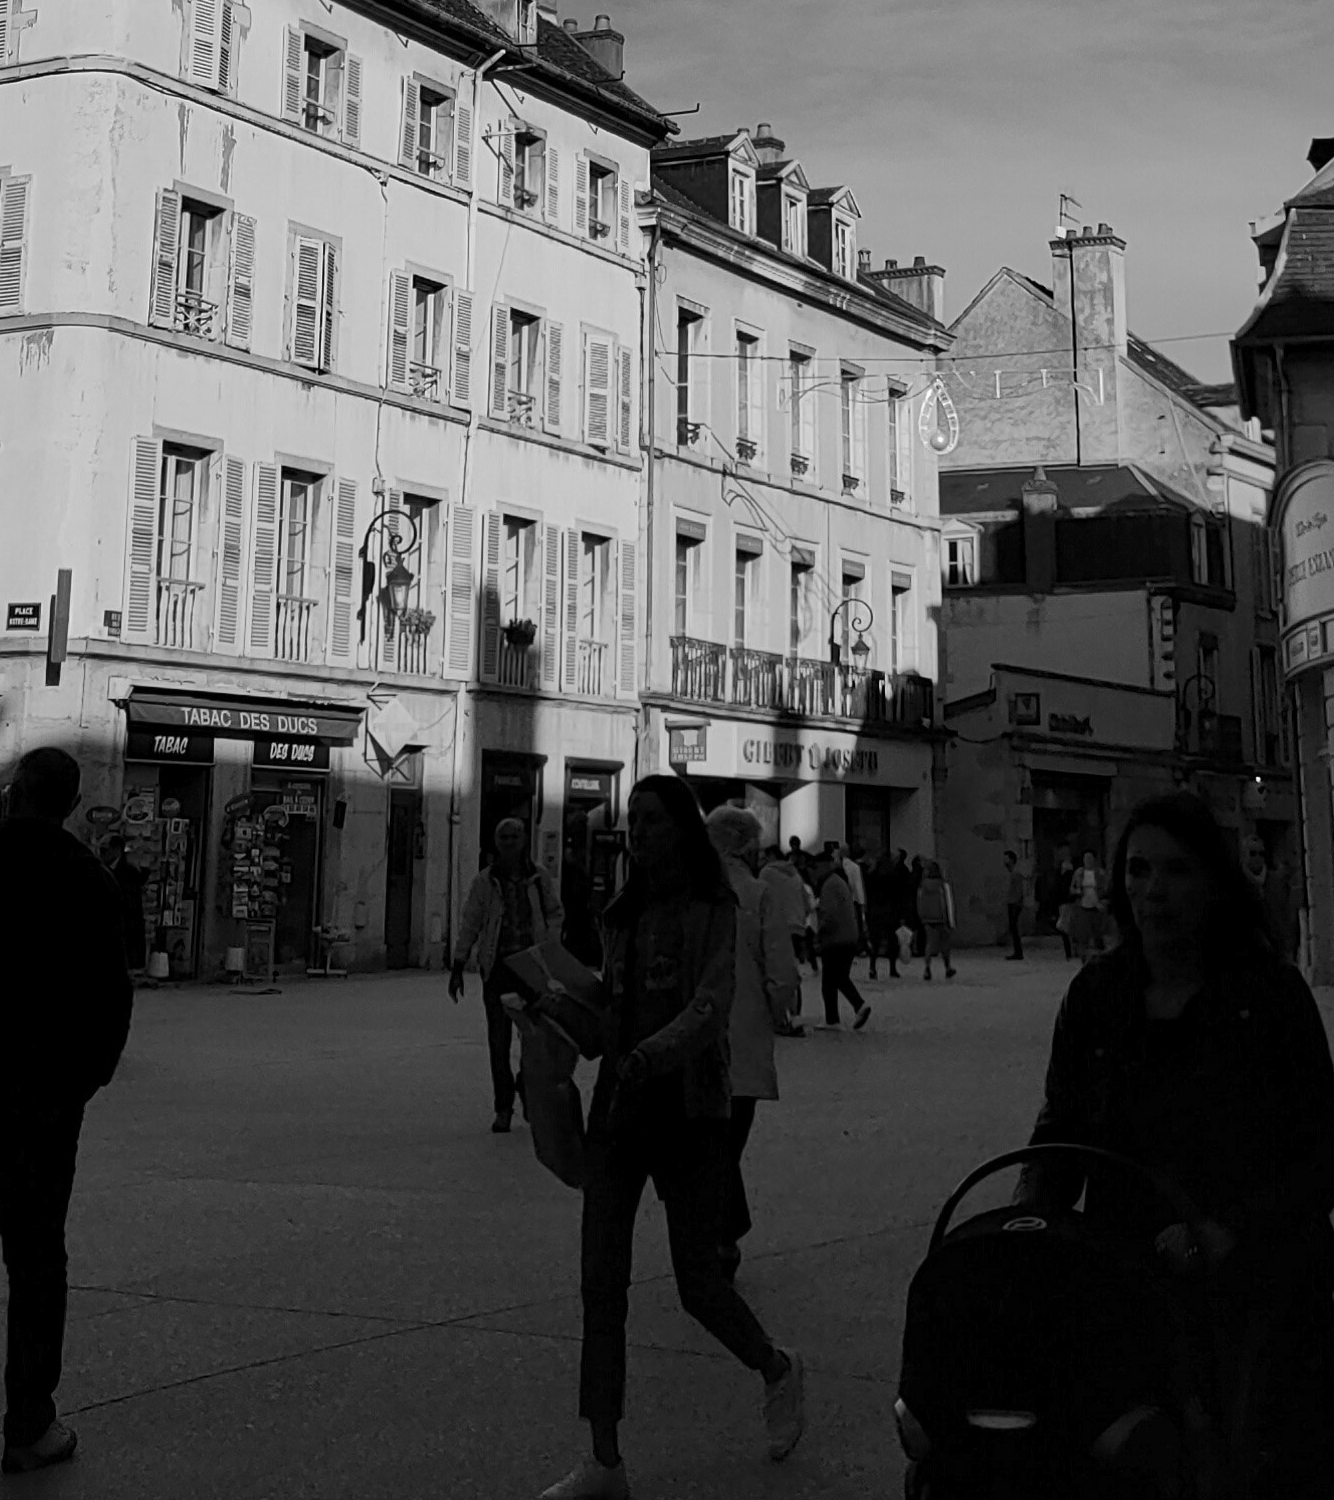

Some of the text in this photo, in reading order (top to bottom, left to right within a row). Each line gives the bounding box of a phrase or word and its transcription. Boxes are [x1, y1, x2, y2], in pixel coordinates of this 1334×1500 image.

[14, 607, 34, 616] PLACE
[180, 707, 318, 735] TABAC DES DUCS
[153, 735, 189, 755] TABAC
[269, 741, 316, 763] DES DUCS
